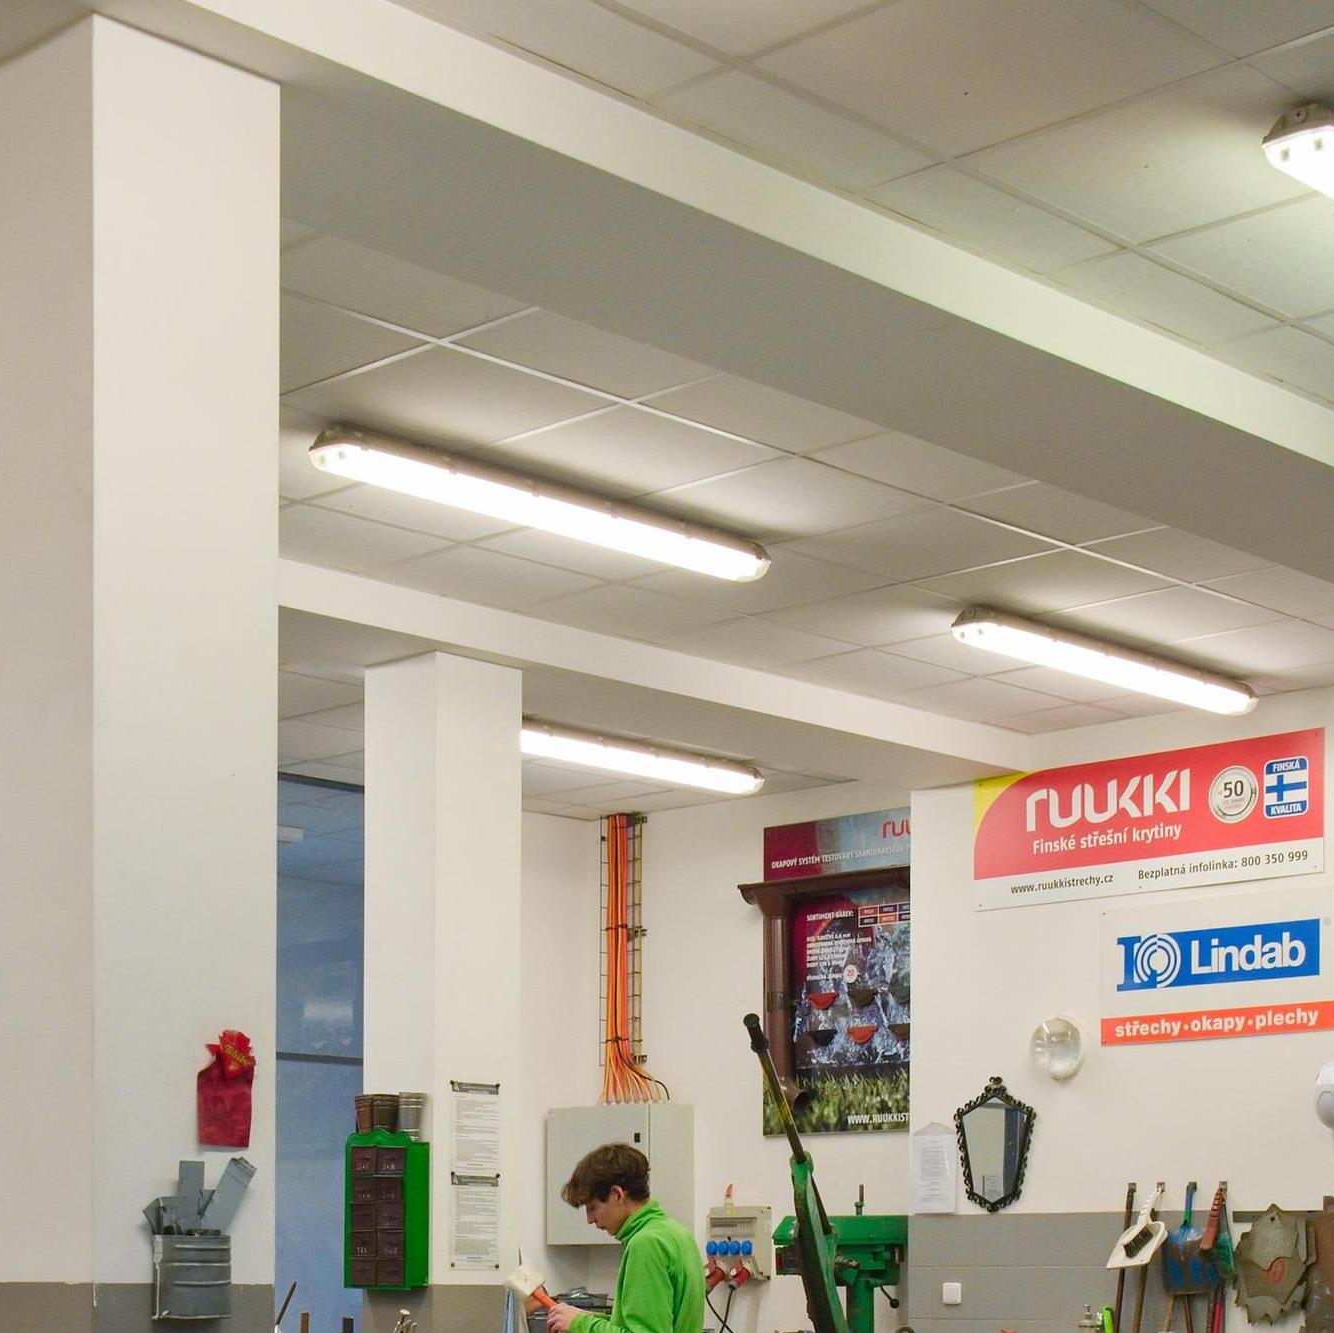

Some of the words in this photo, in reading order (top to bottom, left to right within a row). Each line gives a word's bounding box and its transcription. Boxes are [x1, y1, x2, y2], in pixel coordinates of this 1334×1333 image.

[1272, 758, 1301, 773] FINSKÁ
[1223, 780, 1244, 798] 50
[1270, 802, 1303, 816] KVALITA
[1032, 834, 1077, 855] Finské
[1080, 827, 1128, 846] střešní
[1132, 822, 1182, 845] krytiny
[1138, 863, 1187, 881] Bezplatná
[1189, 859, 1238, 875] infolinka:
[1241, 854, 1262, 868] 800
[1265, 852, 1286, 866] 350
[1289, 850, 1309, 863] 999
[1011, 873, 1114, 894] www.ruukkistrechy.cz
[1191, 931, 1306, 975] Lindab
[847, 1112, 910, 1125] WWW.RUUKKIST
